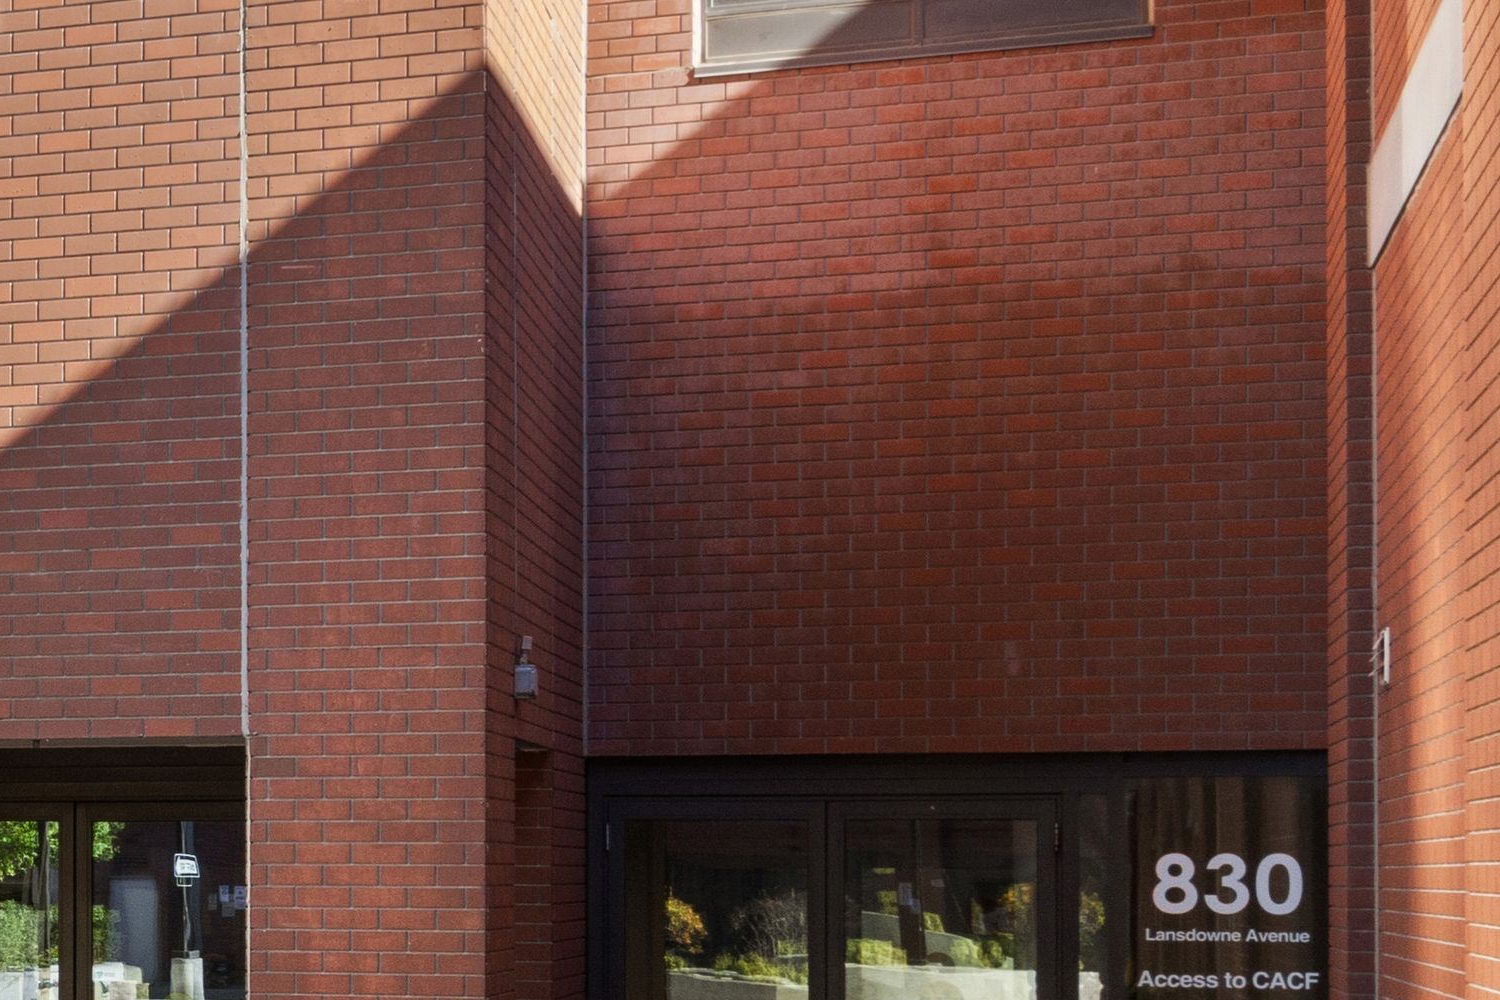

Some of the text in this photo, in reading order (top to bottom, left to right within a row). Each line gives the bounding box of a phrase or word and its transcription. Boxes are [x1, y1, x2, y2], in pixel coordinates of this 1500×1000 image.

[1152, 852, 1304, 915] 830
[1145, 928, 1311, 943] Lansdowne Avenue
[1137, 970, 1320, 990] Access to CACF
